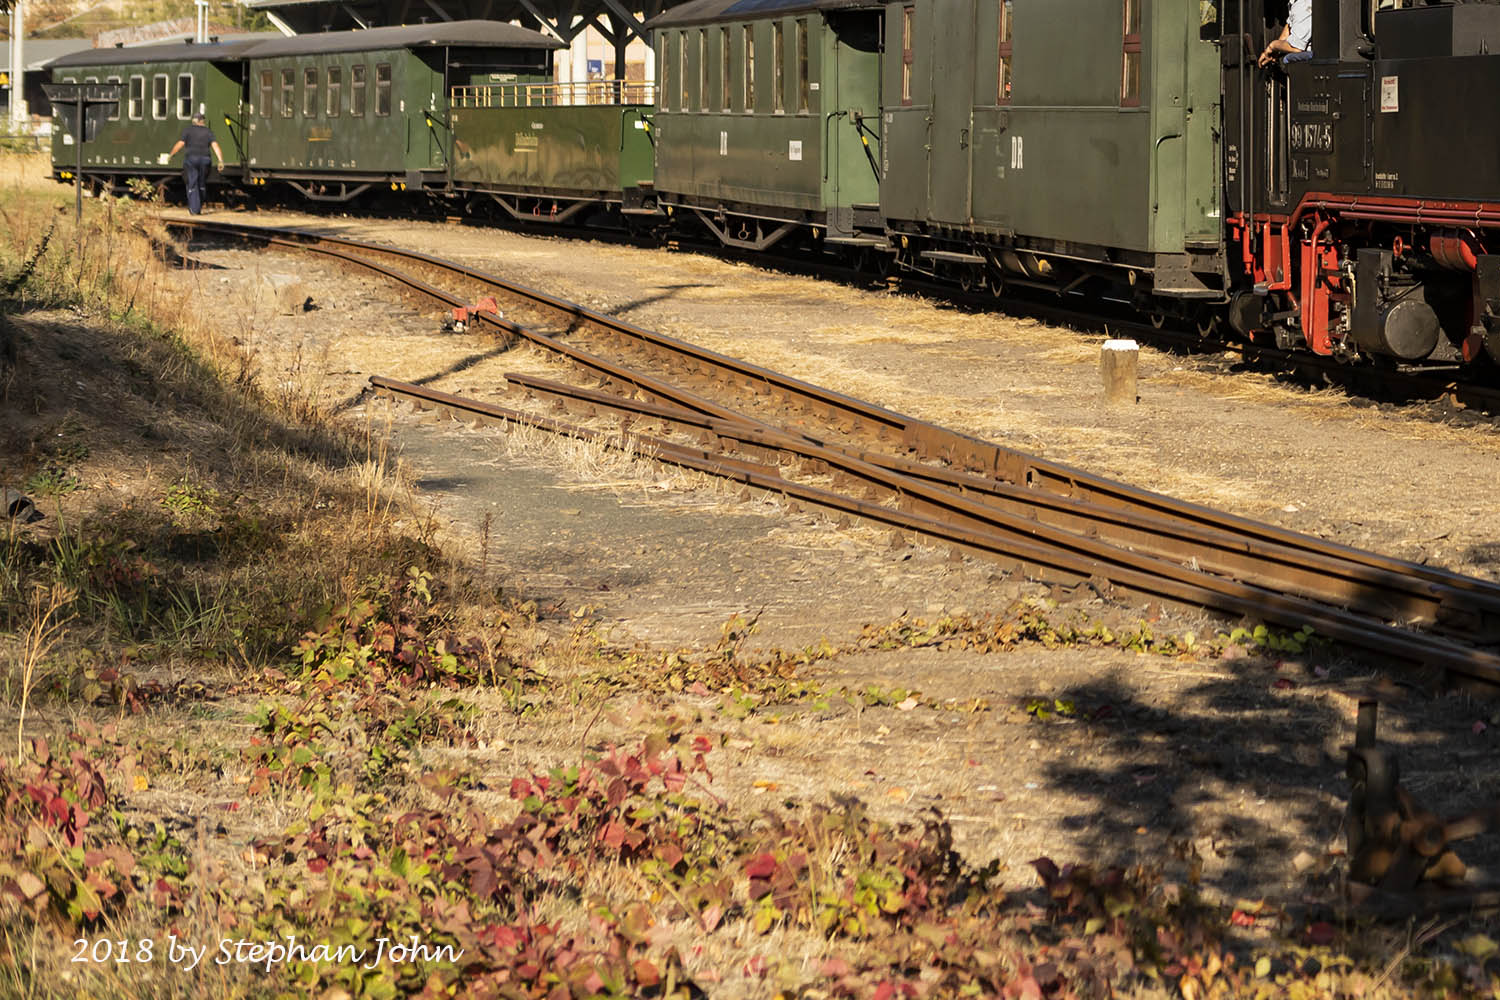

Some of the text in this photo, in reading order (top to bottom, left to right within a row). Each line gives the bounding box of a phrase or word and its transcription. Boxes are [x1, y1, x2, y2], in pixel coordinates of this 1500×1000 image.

[1291, 123, 1331, 149] 99 1574-5
[1011, 135, 1023, 169] DR
